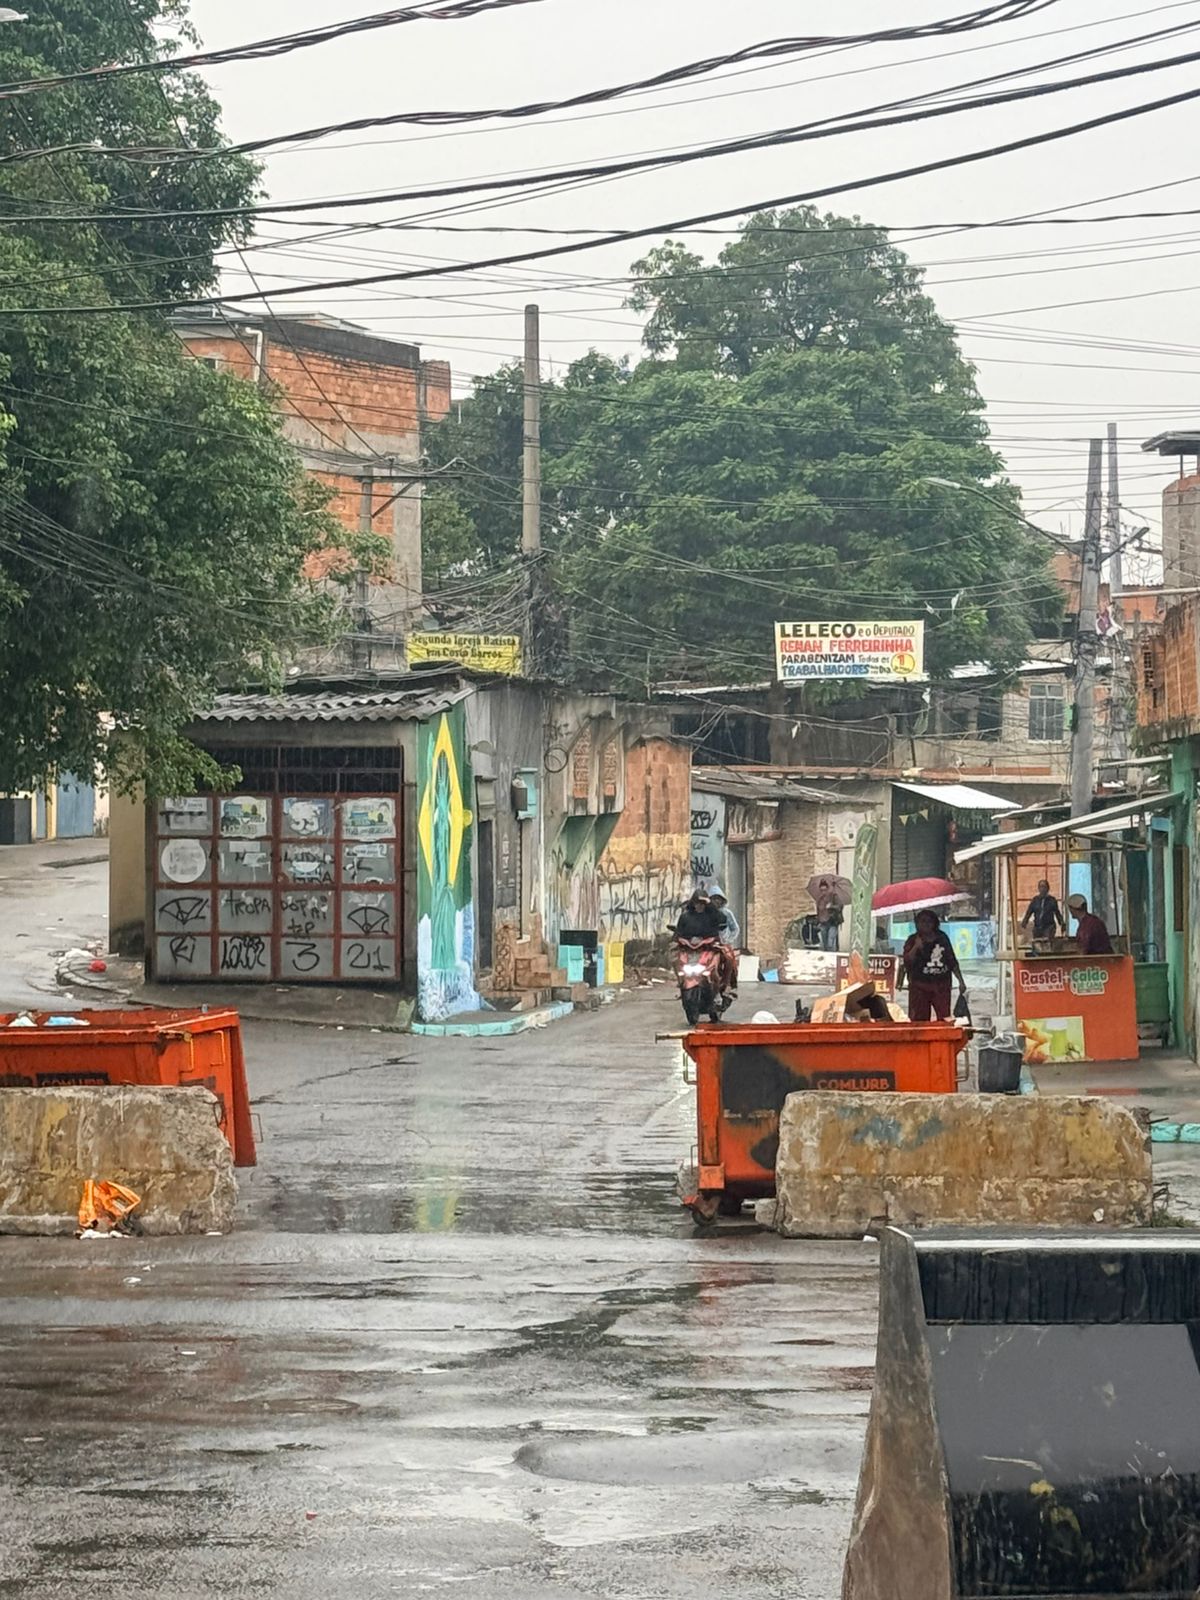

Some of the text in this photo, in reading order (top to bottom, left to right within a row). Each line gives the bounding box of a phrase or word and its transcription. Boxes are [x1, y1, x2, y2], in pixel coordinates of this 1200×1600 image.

[780, 623, 915, 638] LELECO e o DEPUTADO
[780, 639, 914, 653] RENAN FERREIRINHA
[781, 653, 855, 664] PARABENIZAM
[782, 664, 870, 677] TRABALHADORES
[285, 941, 320, 972] 3
[1021, 969, 1062, 985] Pastel
[1071, 968, 1108, 982] Caldo
[817, 1078, 890, 1091] COMLURB
